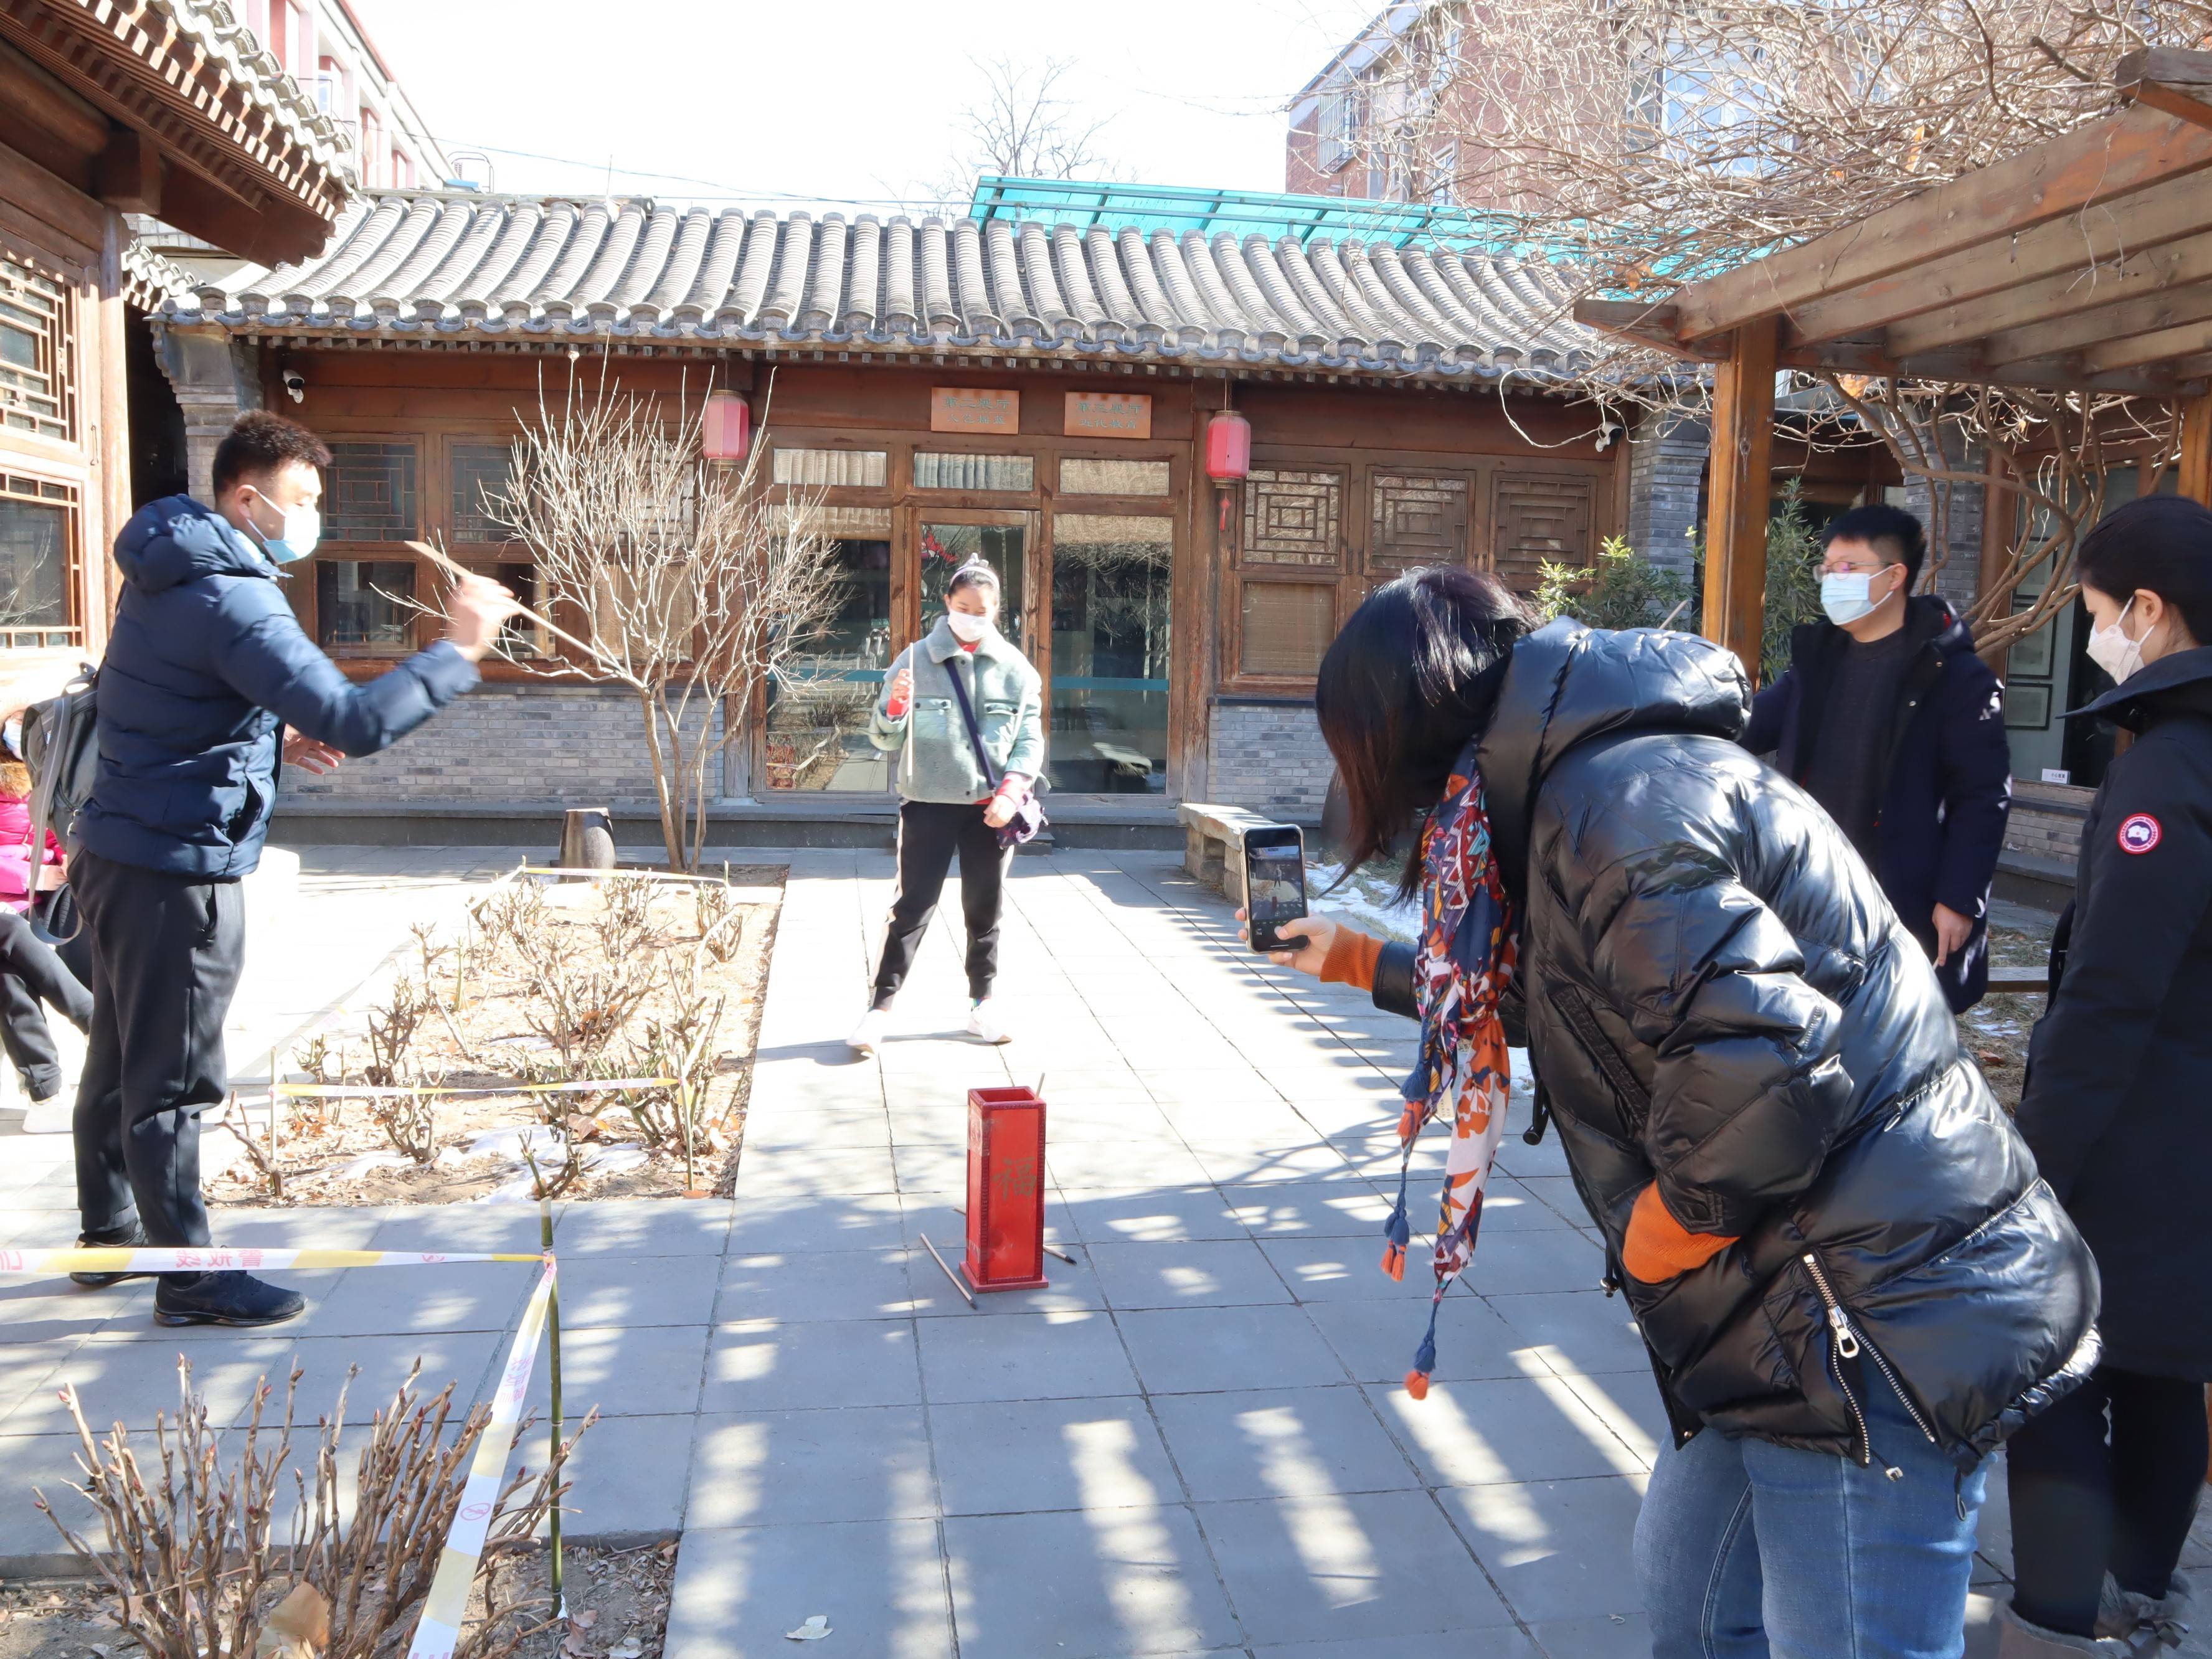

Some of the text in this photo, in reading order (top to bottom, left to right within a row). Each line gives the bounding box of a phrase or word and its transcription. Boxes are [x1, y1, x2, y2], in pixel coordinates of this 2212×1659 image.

[942, 396, 1011, 410] 第二展厅
[1076, 402, 1143, 415] 第三展厅
[993, 1156, 1039, 1201] 福
